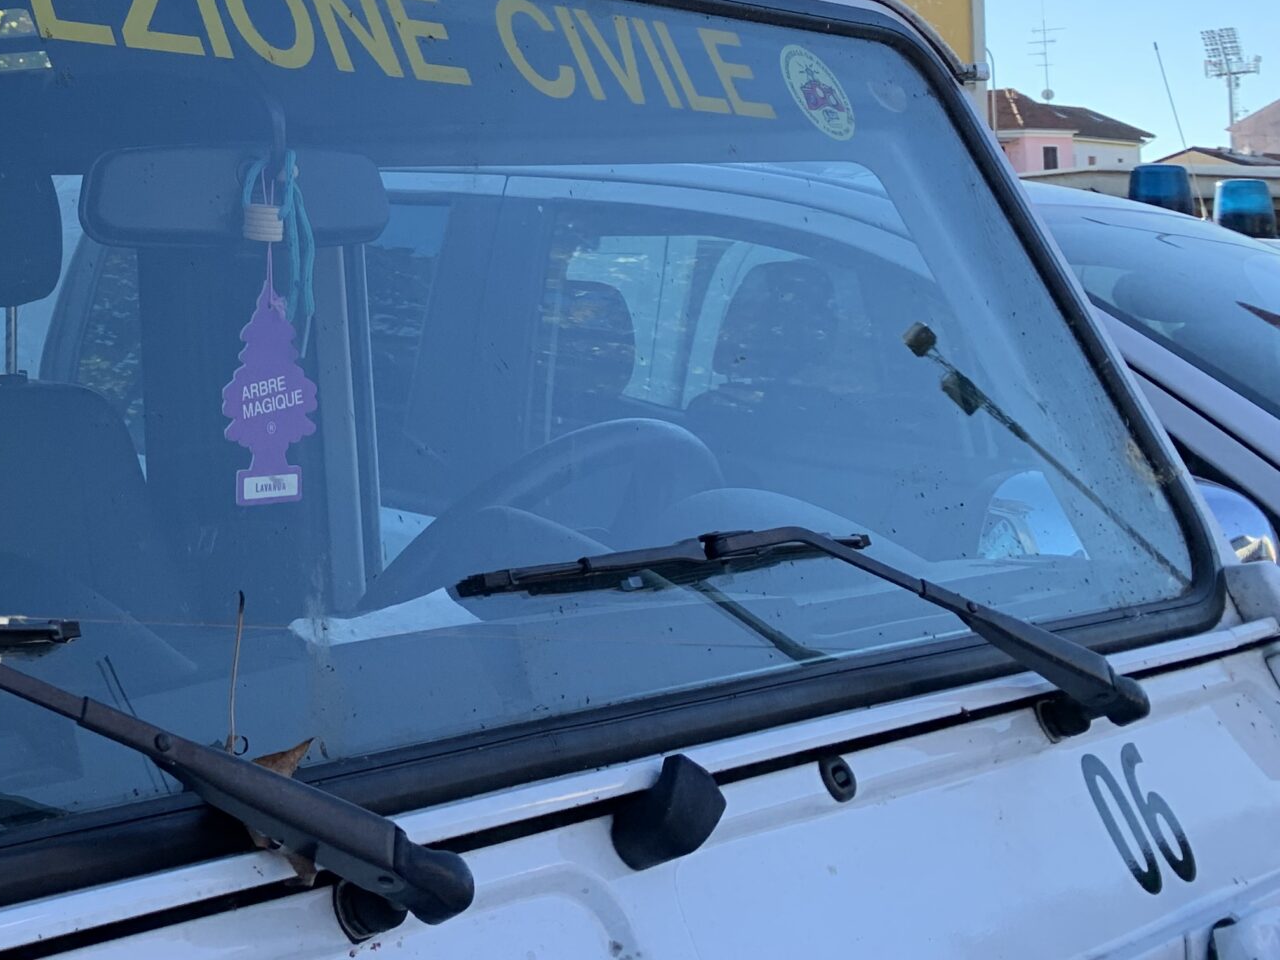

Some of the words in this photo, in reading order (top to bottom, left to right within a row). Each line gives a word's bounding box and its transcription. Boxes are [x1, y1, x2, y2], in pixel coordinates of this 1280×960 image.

[241, 376, 287, 401] ARBRE
[242, 389, 304, 420] MAGIQUE
[1081, 742, 1197, 895] 06
